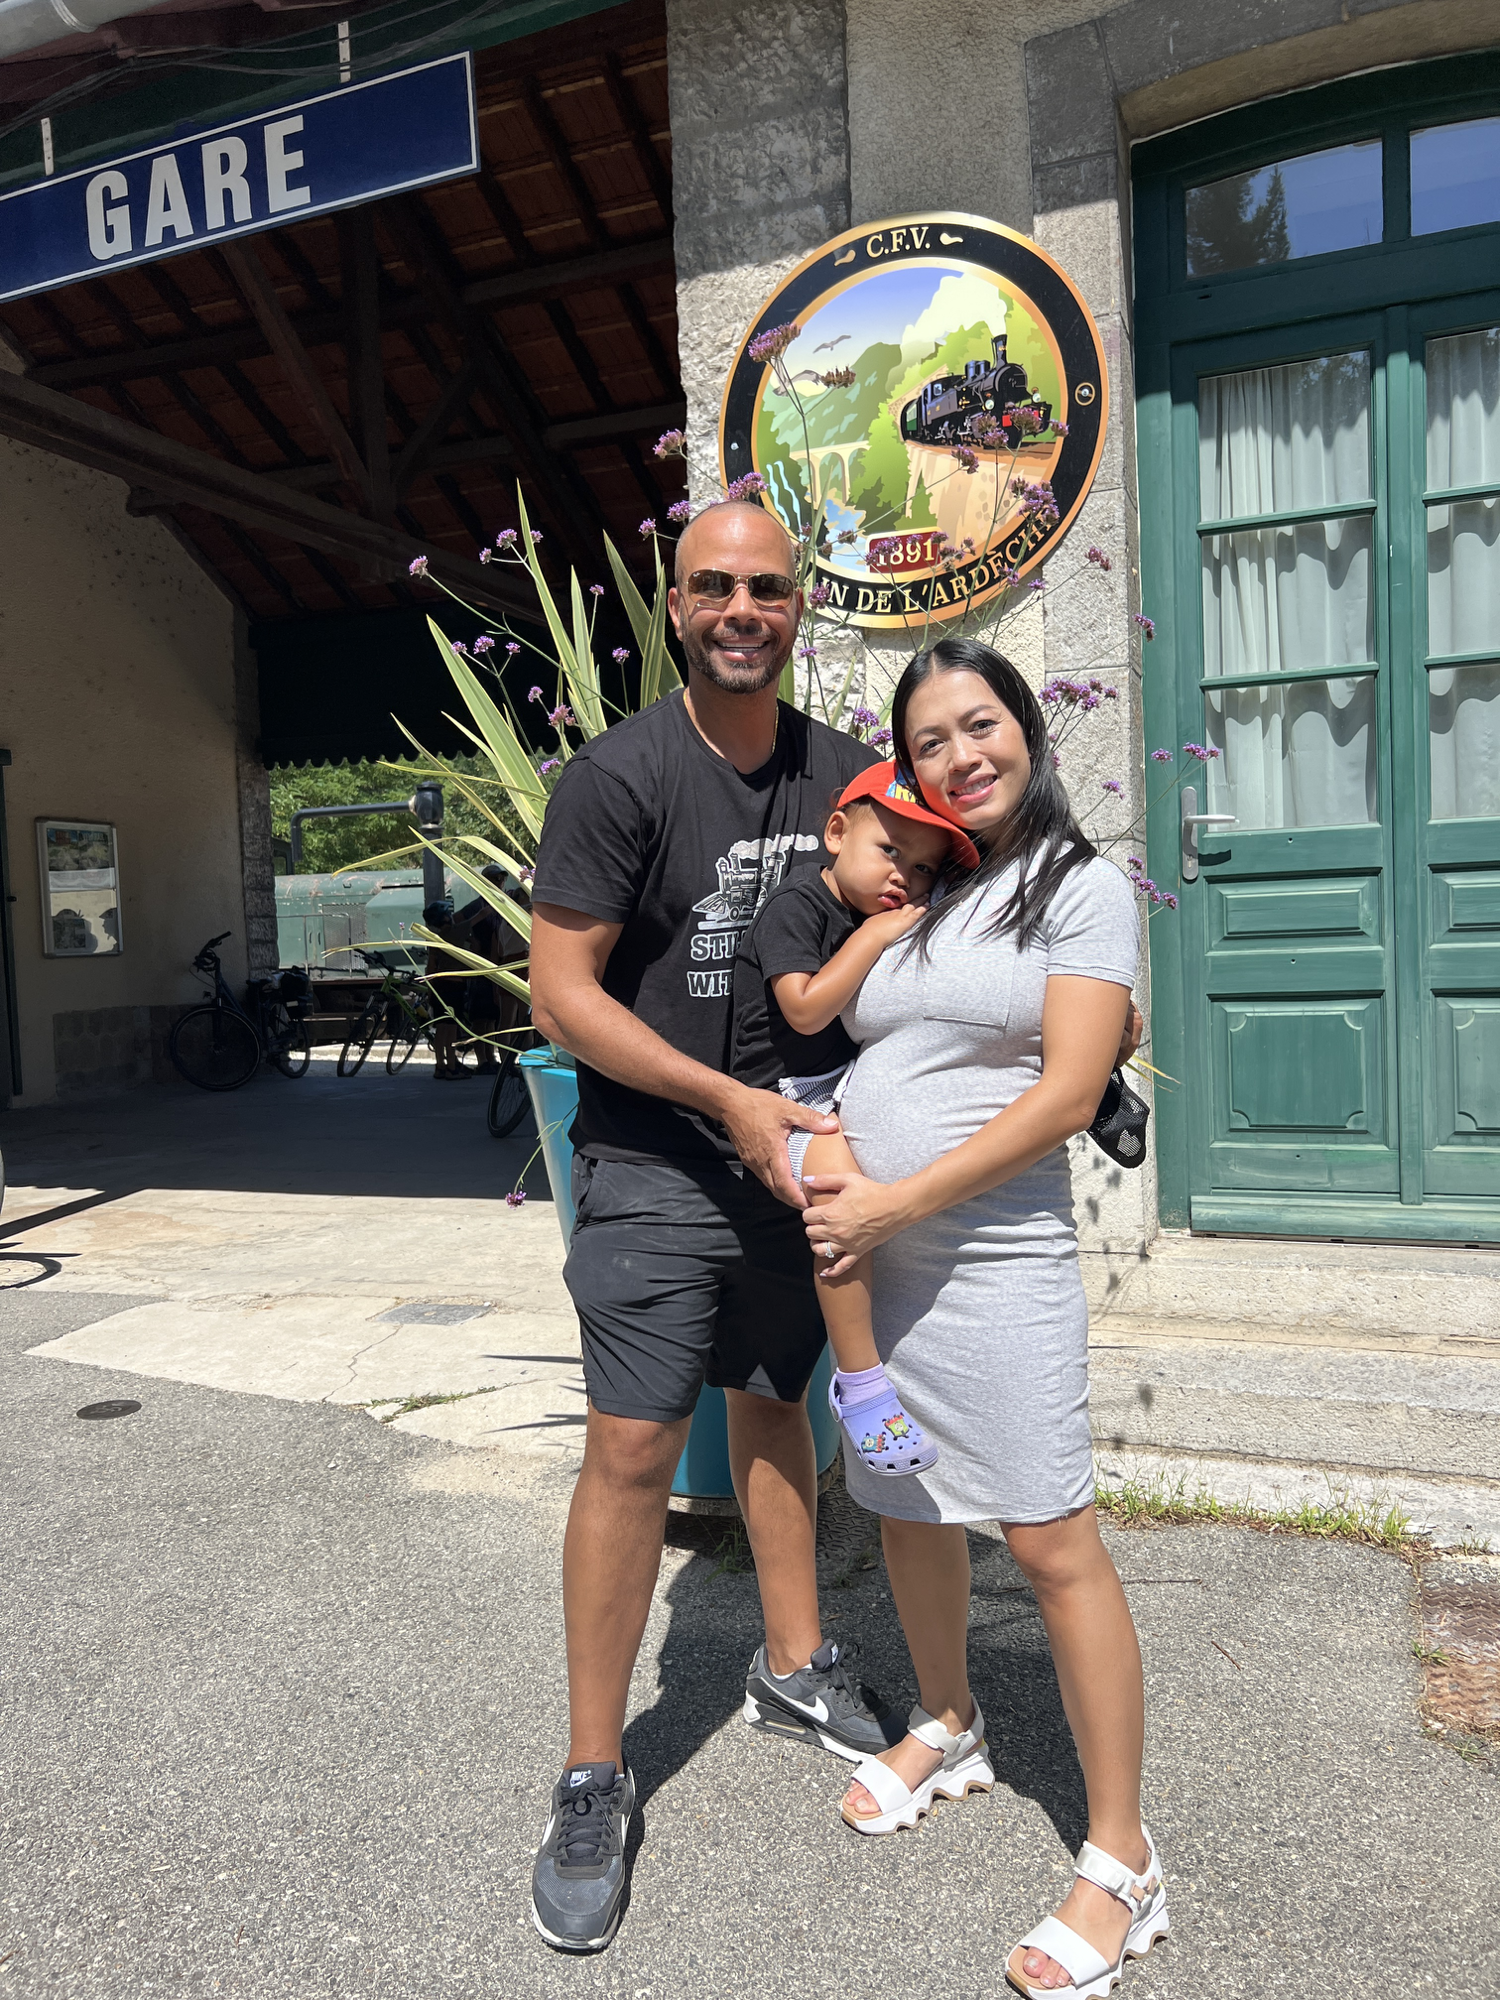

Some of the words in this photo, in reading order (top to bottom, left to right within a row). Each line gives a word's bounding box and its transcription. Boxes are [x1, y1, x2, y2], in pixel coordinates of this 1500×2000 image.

[86, 114, 311, 260] GARE
[866, 226, 931, 258] C.F.V.
[876, 538, 935, 567] 1891
[855, 587, 892, 613] DE
[687, 968, 733, 998] WIT
